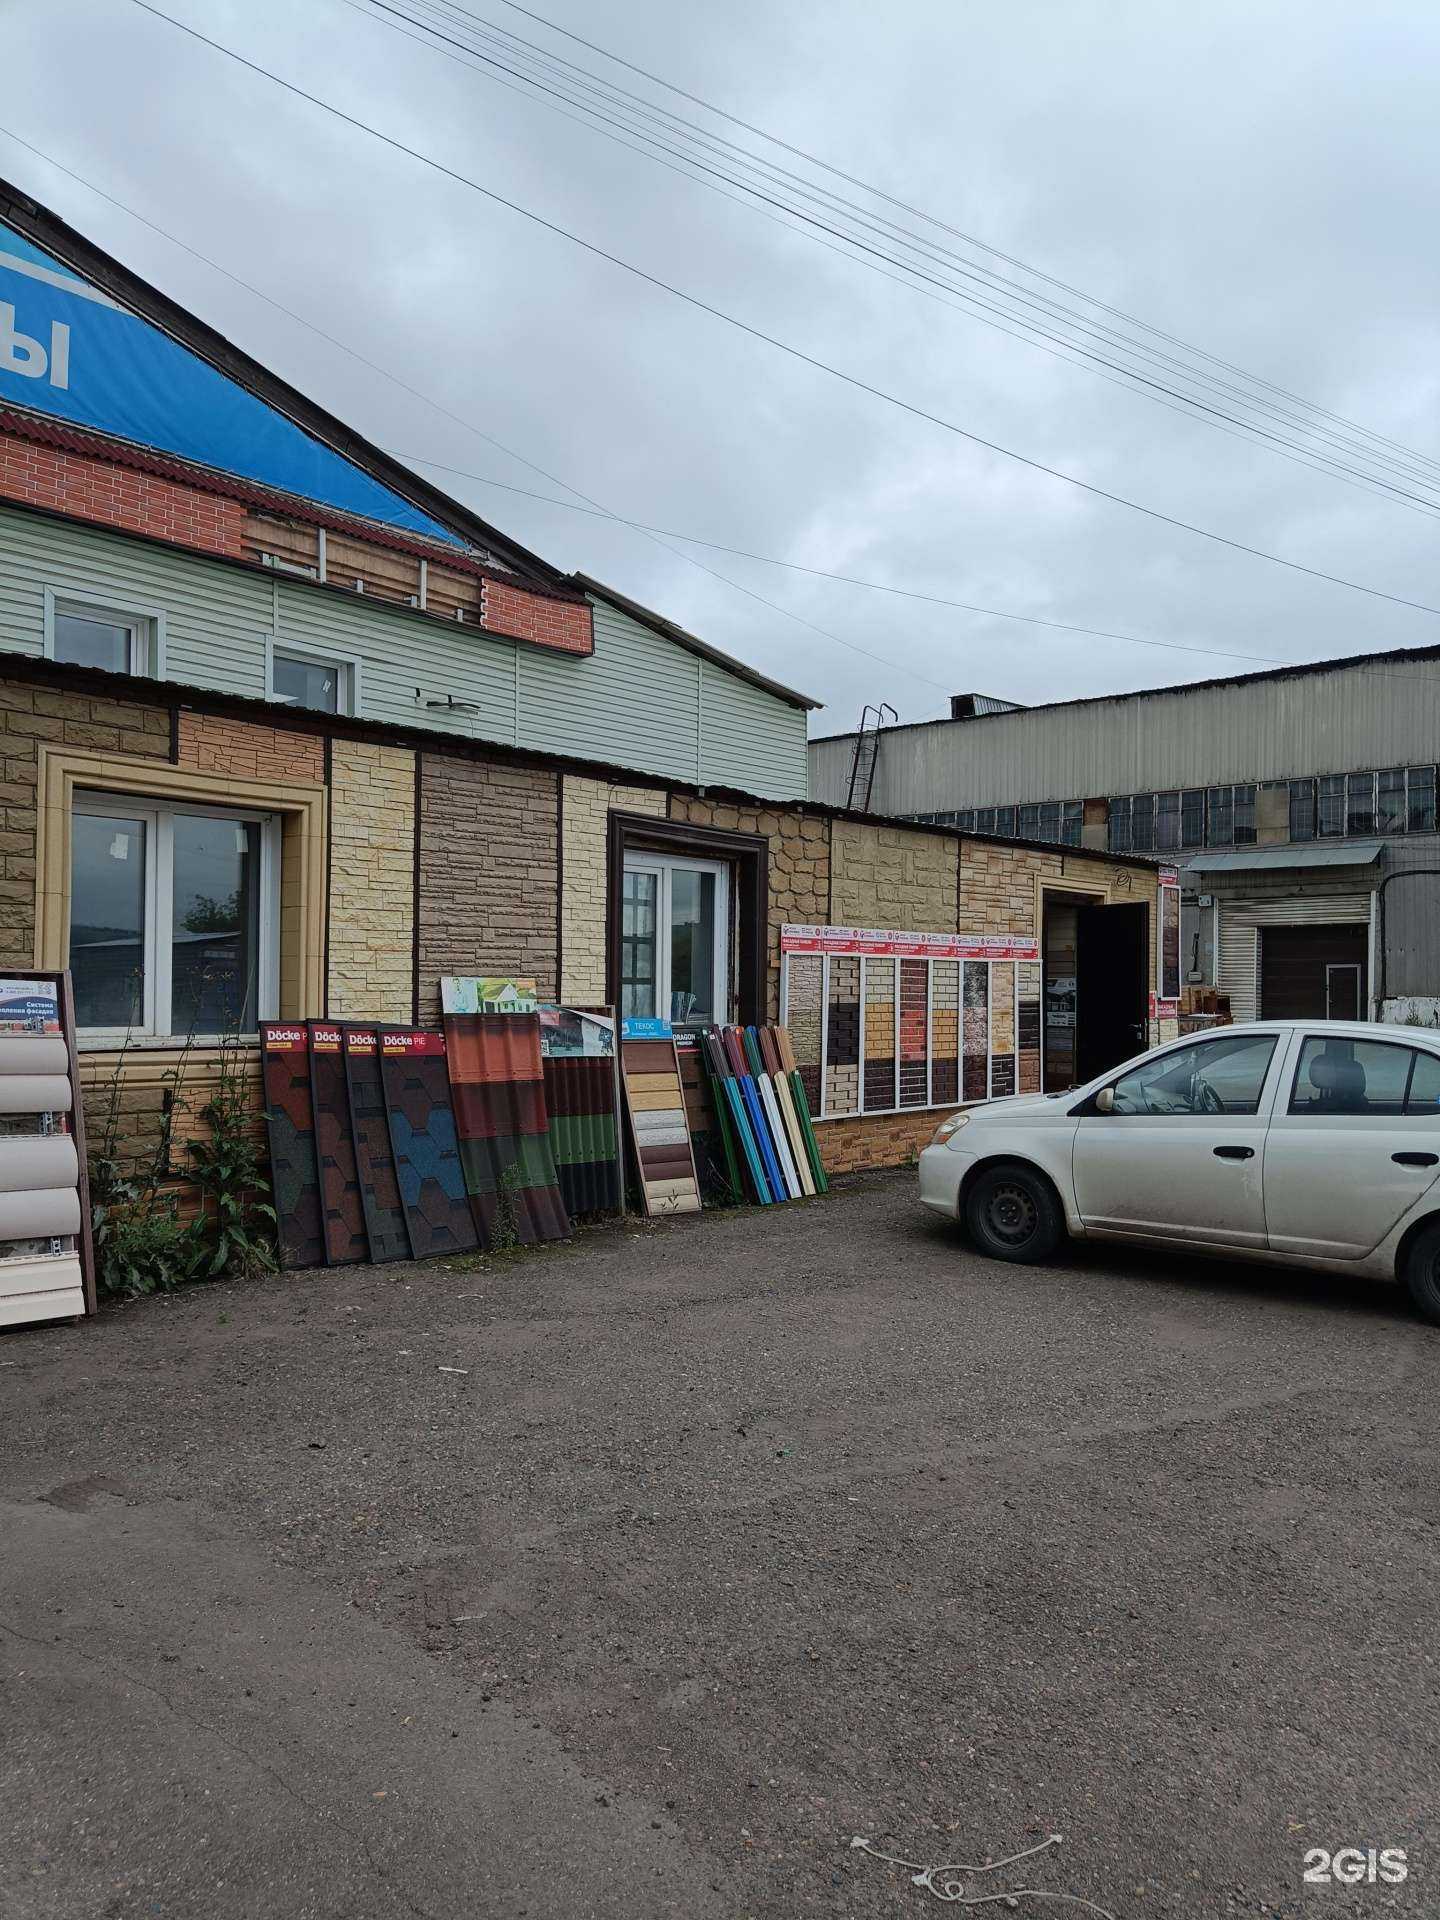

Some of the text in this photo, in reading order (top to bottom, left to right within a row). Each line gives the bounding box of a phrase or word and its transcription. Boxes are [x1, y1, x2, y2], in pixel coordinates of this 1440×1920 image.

[267, 1030, 300, 1041] Döcke
[314, 1031, 342, 1042] Döck
[383, 1036, 425, 1046] Döcke PIE
